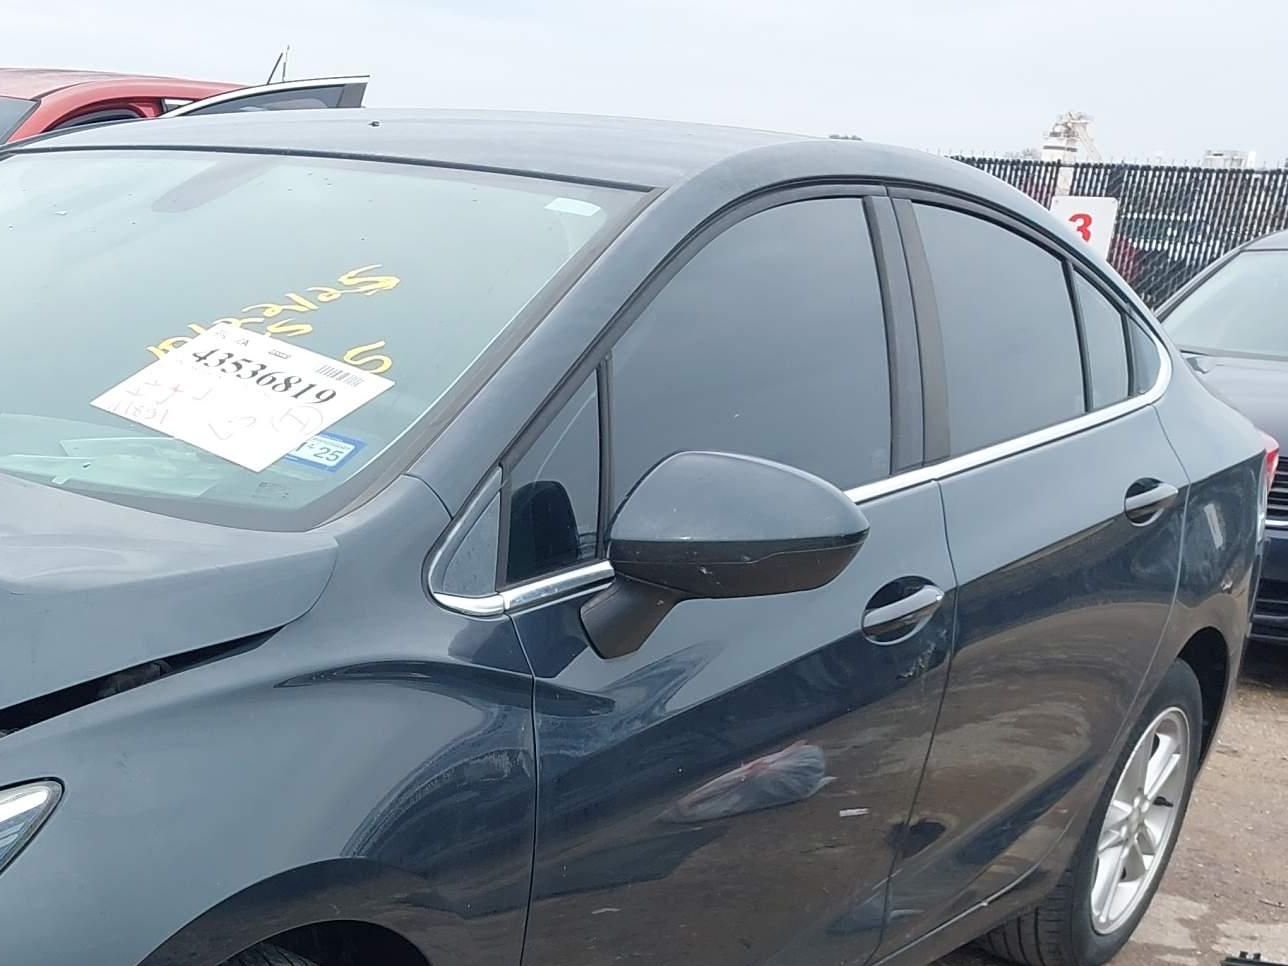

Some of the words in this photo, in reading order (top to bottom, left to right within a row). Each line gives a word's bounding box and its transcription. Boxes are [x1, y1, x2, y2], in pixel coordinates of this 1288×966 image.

[1068, 212, 1093, 243] 3
[191, 348, 338, 406] 43536819
[313, 446, 344, 462] 25
